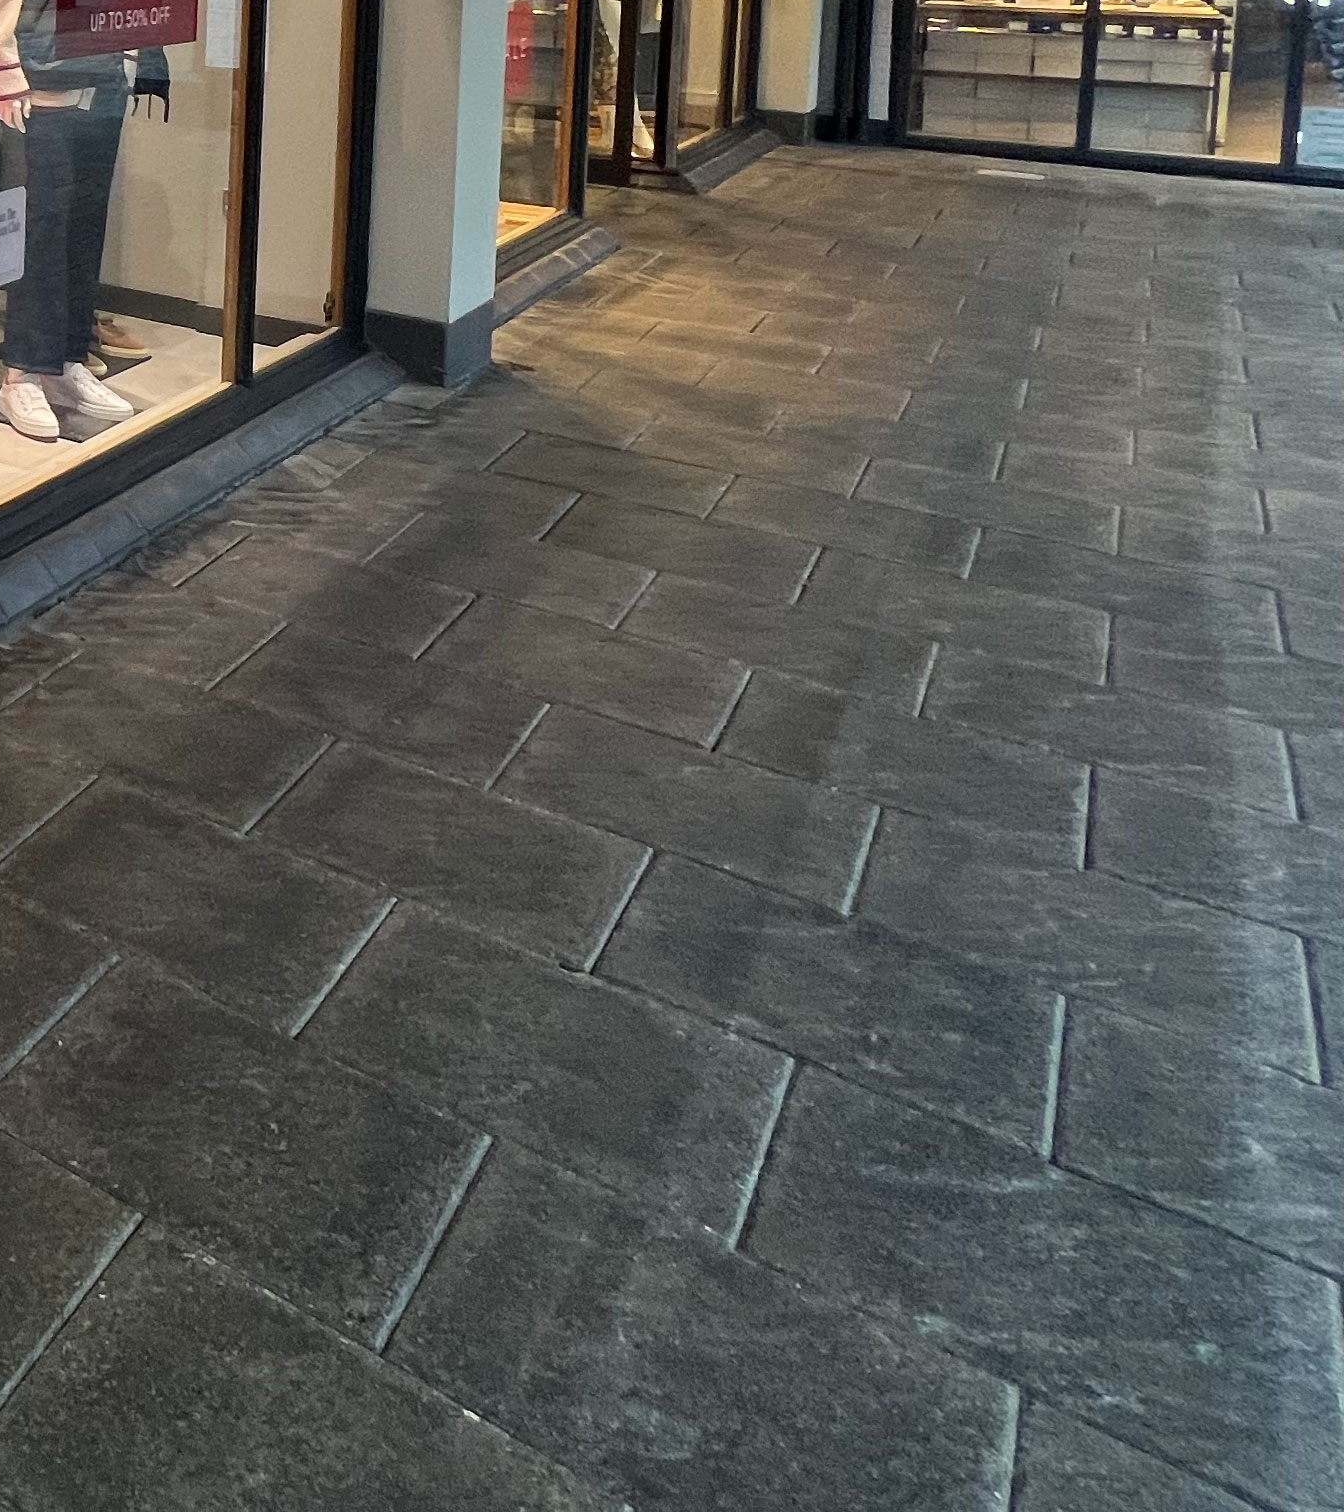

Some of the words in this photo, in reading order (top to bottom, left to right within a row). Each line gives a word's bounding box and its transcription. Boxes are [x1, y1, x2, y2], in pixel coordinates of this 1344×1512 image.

[90, 12, 107, 33] UP
[108, 10, 124, 30] TO
[125, 8, 148, 29] 50%
[149, 5, 171, 26] OFF
